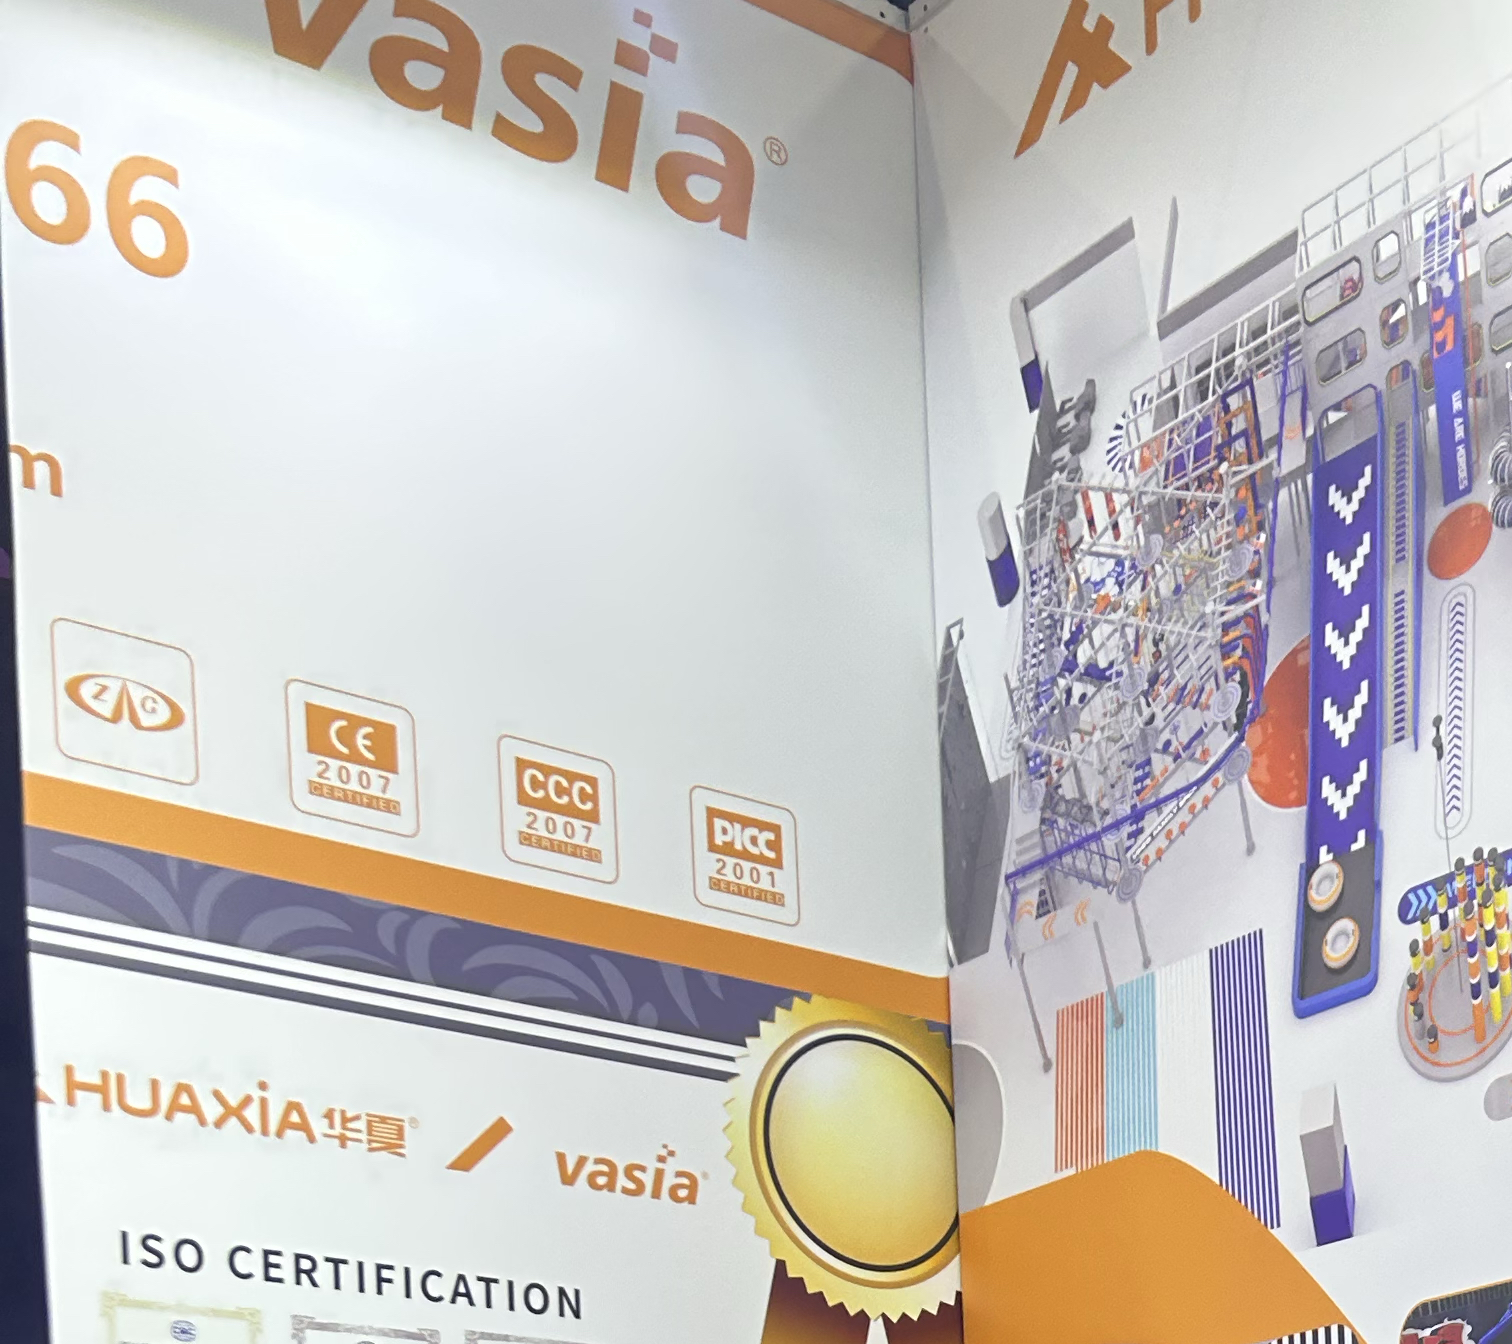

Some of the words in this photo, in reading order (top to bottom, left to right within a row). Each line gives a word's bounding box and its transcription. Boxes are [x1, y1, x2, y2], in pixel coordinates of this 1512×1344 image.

[316, 760, 392, 796] 2007
[522, 768, 595, 815] CCC
[525, 810, 595, 844] 2007
[712, 816, 778, 860] PICC
[715, 858, 779, 890] 2001
[553, 1143, 700, 1206] vasia
[117, 1229, 205, 1276] ISO
[226, 1244, 585, 1321] CERTIFICATION
